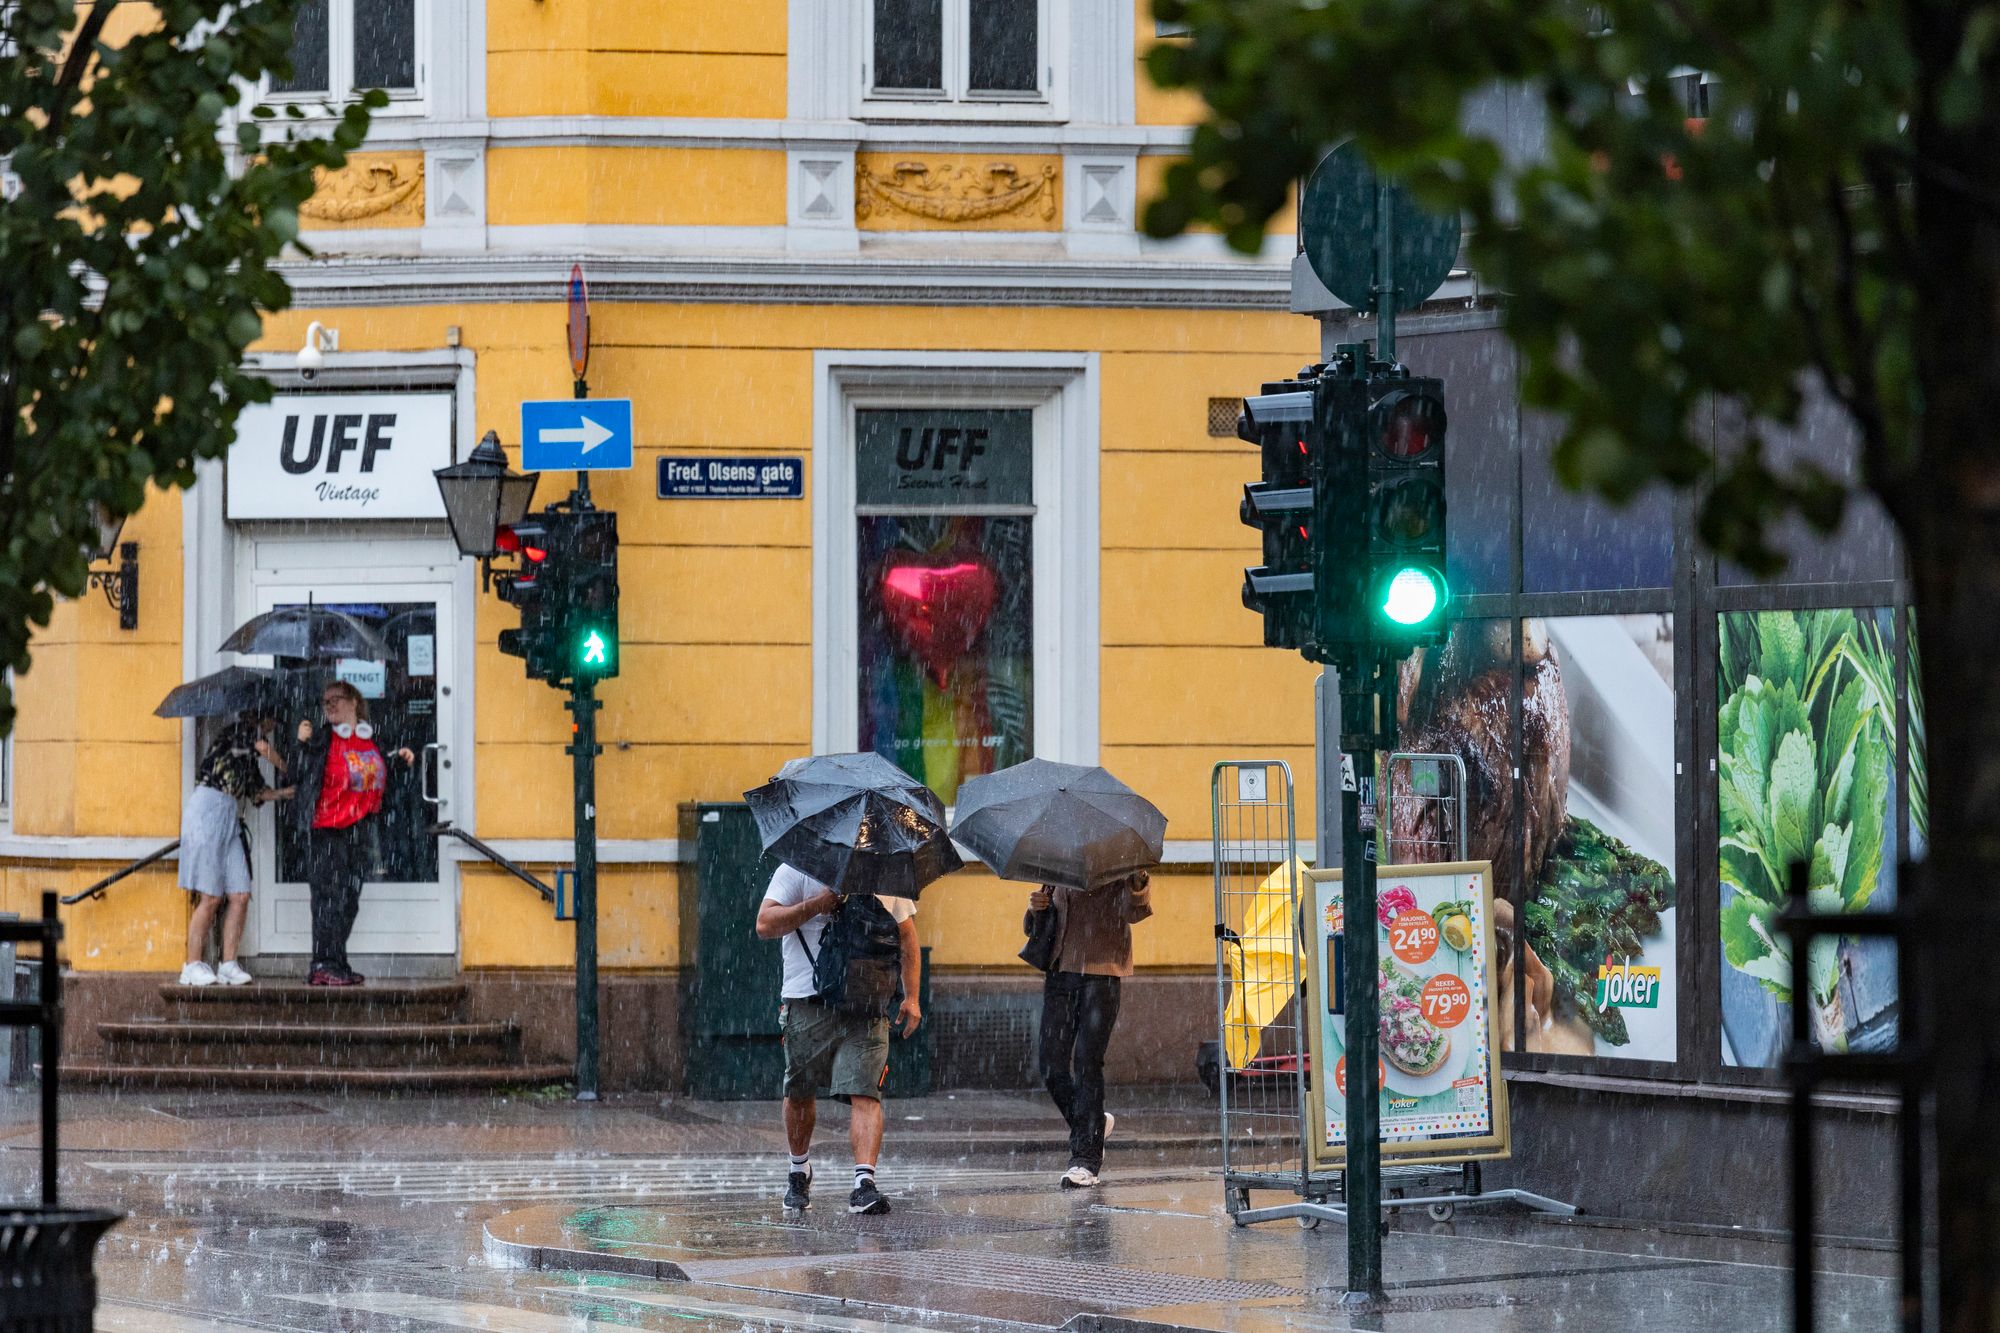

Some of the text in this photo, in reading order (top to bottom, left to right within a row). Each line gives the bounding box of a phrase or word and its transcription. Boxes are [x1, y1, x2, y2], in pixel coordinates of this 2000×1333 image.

[280, 414, 397, 474] UFF
[896, 428, 988, 471] UFF
[668, 462, 794, 485] Fred. Olsens gate
[898, 475, 944, 489] Second
[315, 481, 380, 507] Vintage
[982, 736, 1004, 747] UFF
[1599, 954, 1656, 1013] joker
[1391, 1098, 1415, 1110] joker
